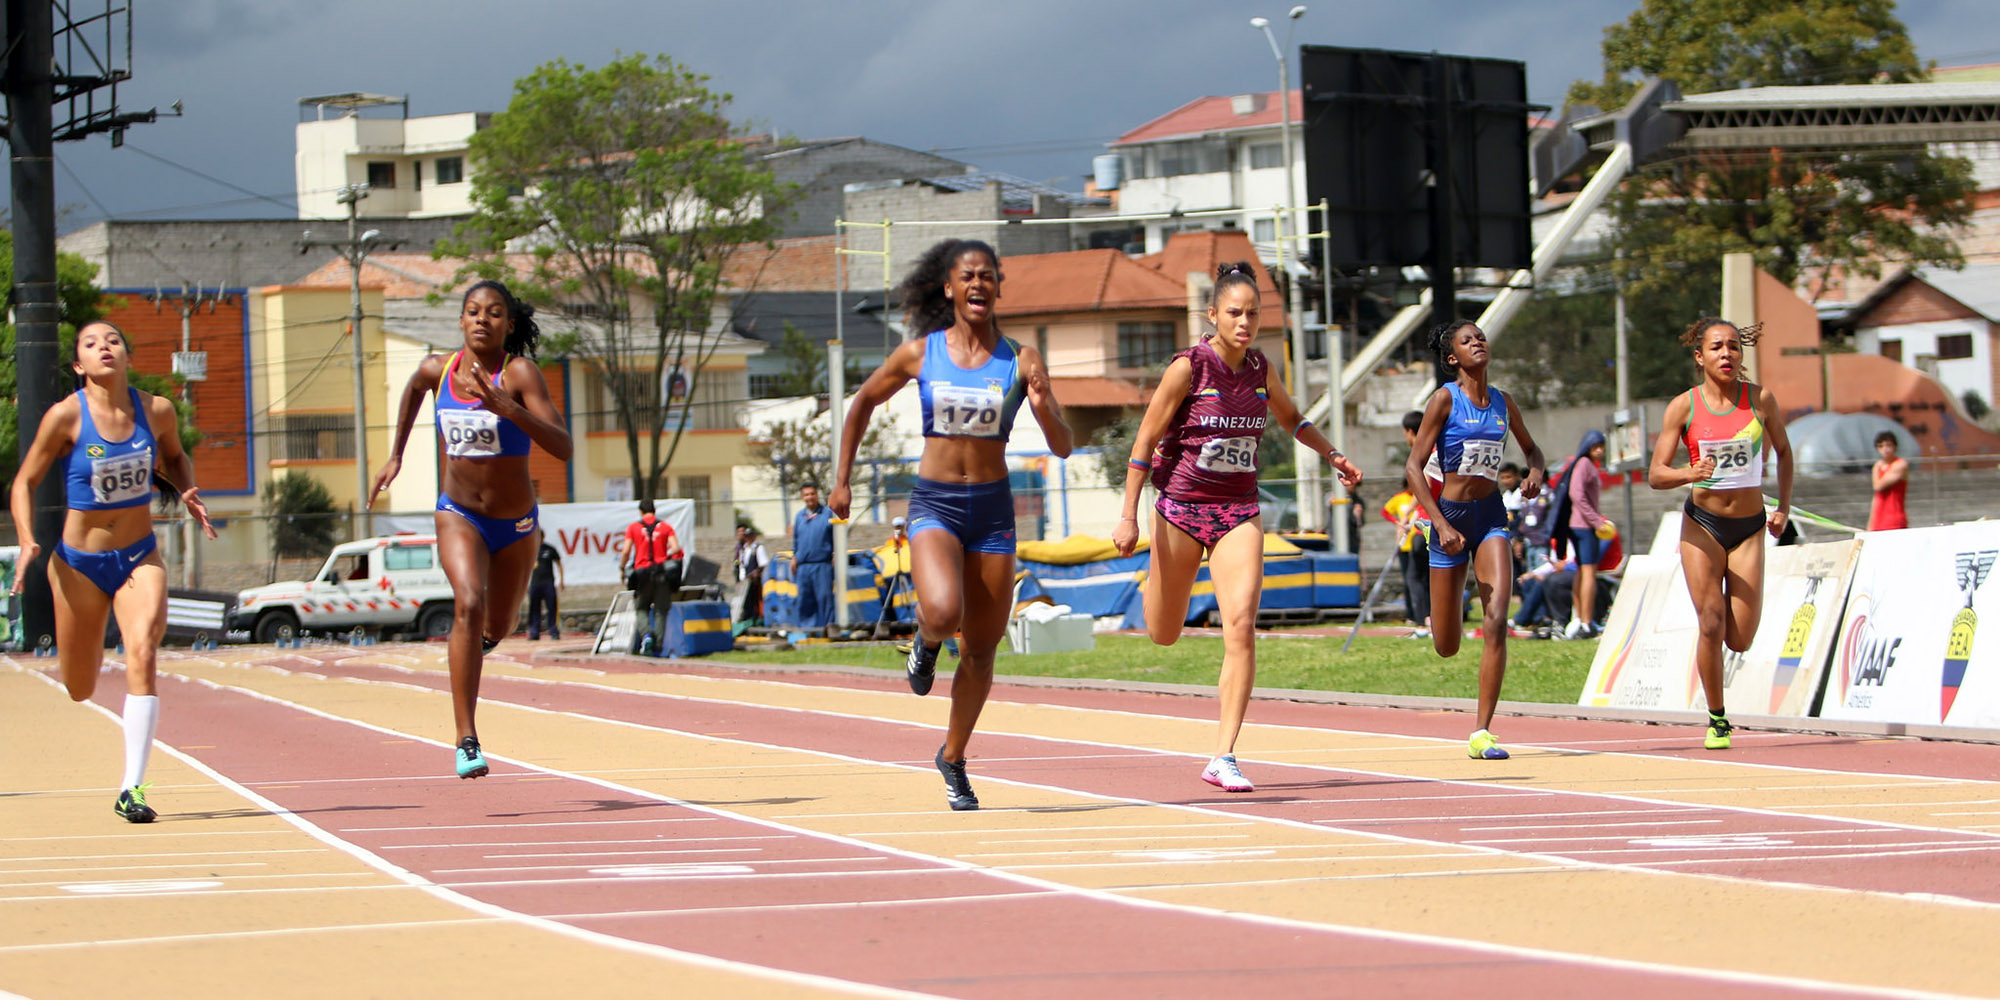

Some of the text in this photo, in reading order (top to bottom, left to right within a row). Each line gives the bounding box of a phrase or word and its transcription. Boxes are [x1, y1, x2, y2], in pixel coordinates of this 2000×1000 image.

[942, 405, 997, 425] 170
[1199, 415, 1267, 429] VENEZUEL
[449, 427, 495, 445] 099
[1208, 445, 1251, 468] 259
[1469, 453, 1501, 471] 142
[102, 468, 147, 493] 050
[1854, 637, 1903, 687] IAAF
